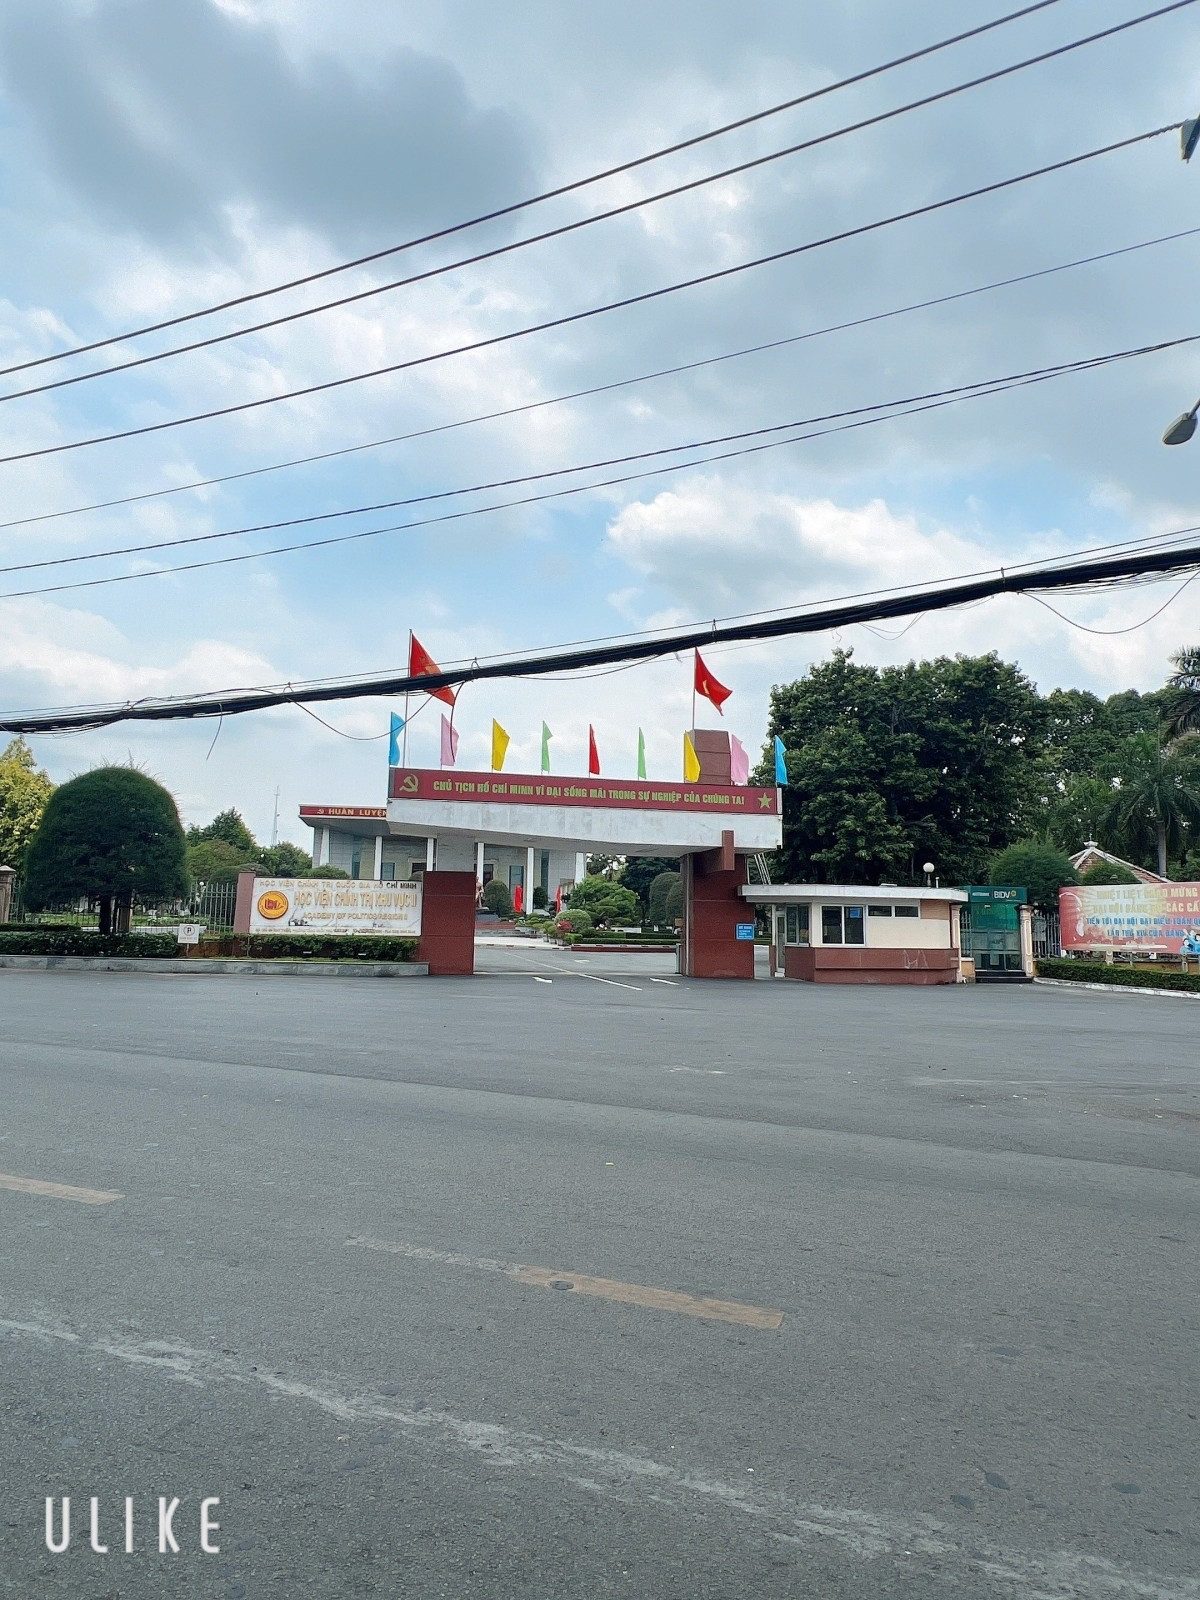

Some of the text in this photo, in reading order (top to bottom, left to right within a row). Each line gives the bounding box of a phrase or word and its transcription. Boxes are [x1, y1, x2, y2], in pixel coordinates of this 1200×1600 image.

[433, 779, 452, 791] CHỦ
[455, 781, 475, 793] TỊCH
[492, 782, 508, 794] CHÍ
[510, 784, 534, 795] MINH
[546, 786, 561, 798] ĐẠI
[563, 785, 588, 798] SỐNG
[608, 789, 636, 800] TRONG
[638, 790, 650, 802] SỰ
[651, 791, 682, 803] NGHIỆP
[684, 791, 700, 803] CỦA
[702, 793, 730, 804] CHÚNG
[993, 890, 1011, 898] BIDV
[1171, 887, 1198, 897] MỪNG
[294, 891, 312, 908] HỌC
[314, 889, 333, 908] VIỆN
[334, 889, 358, 907] CHÍNH
[1186, 900, 1200, 912] CẤ
